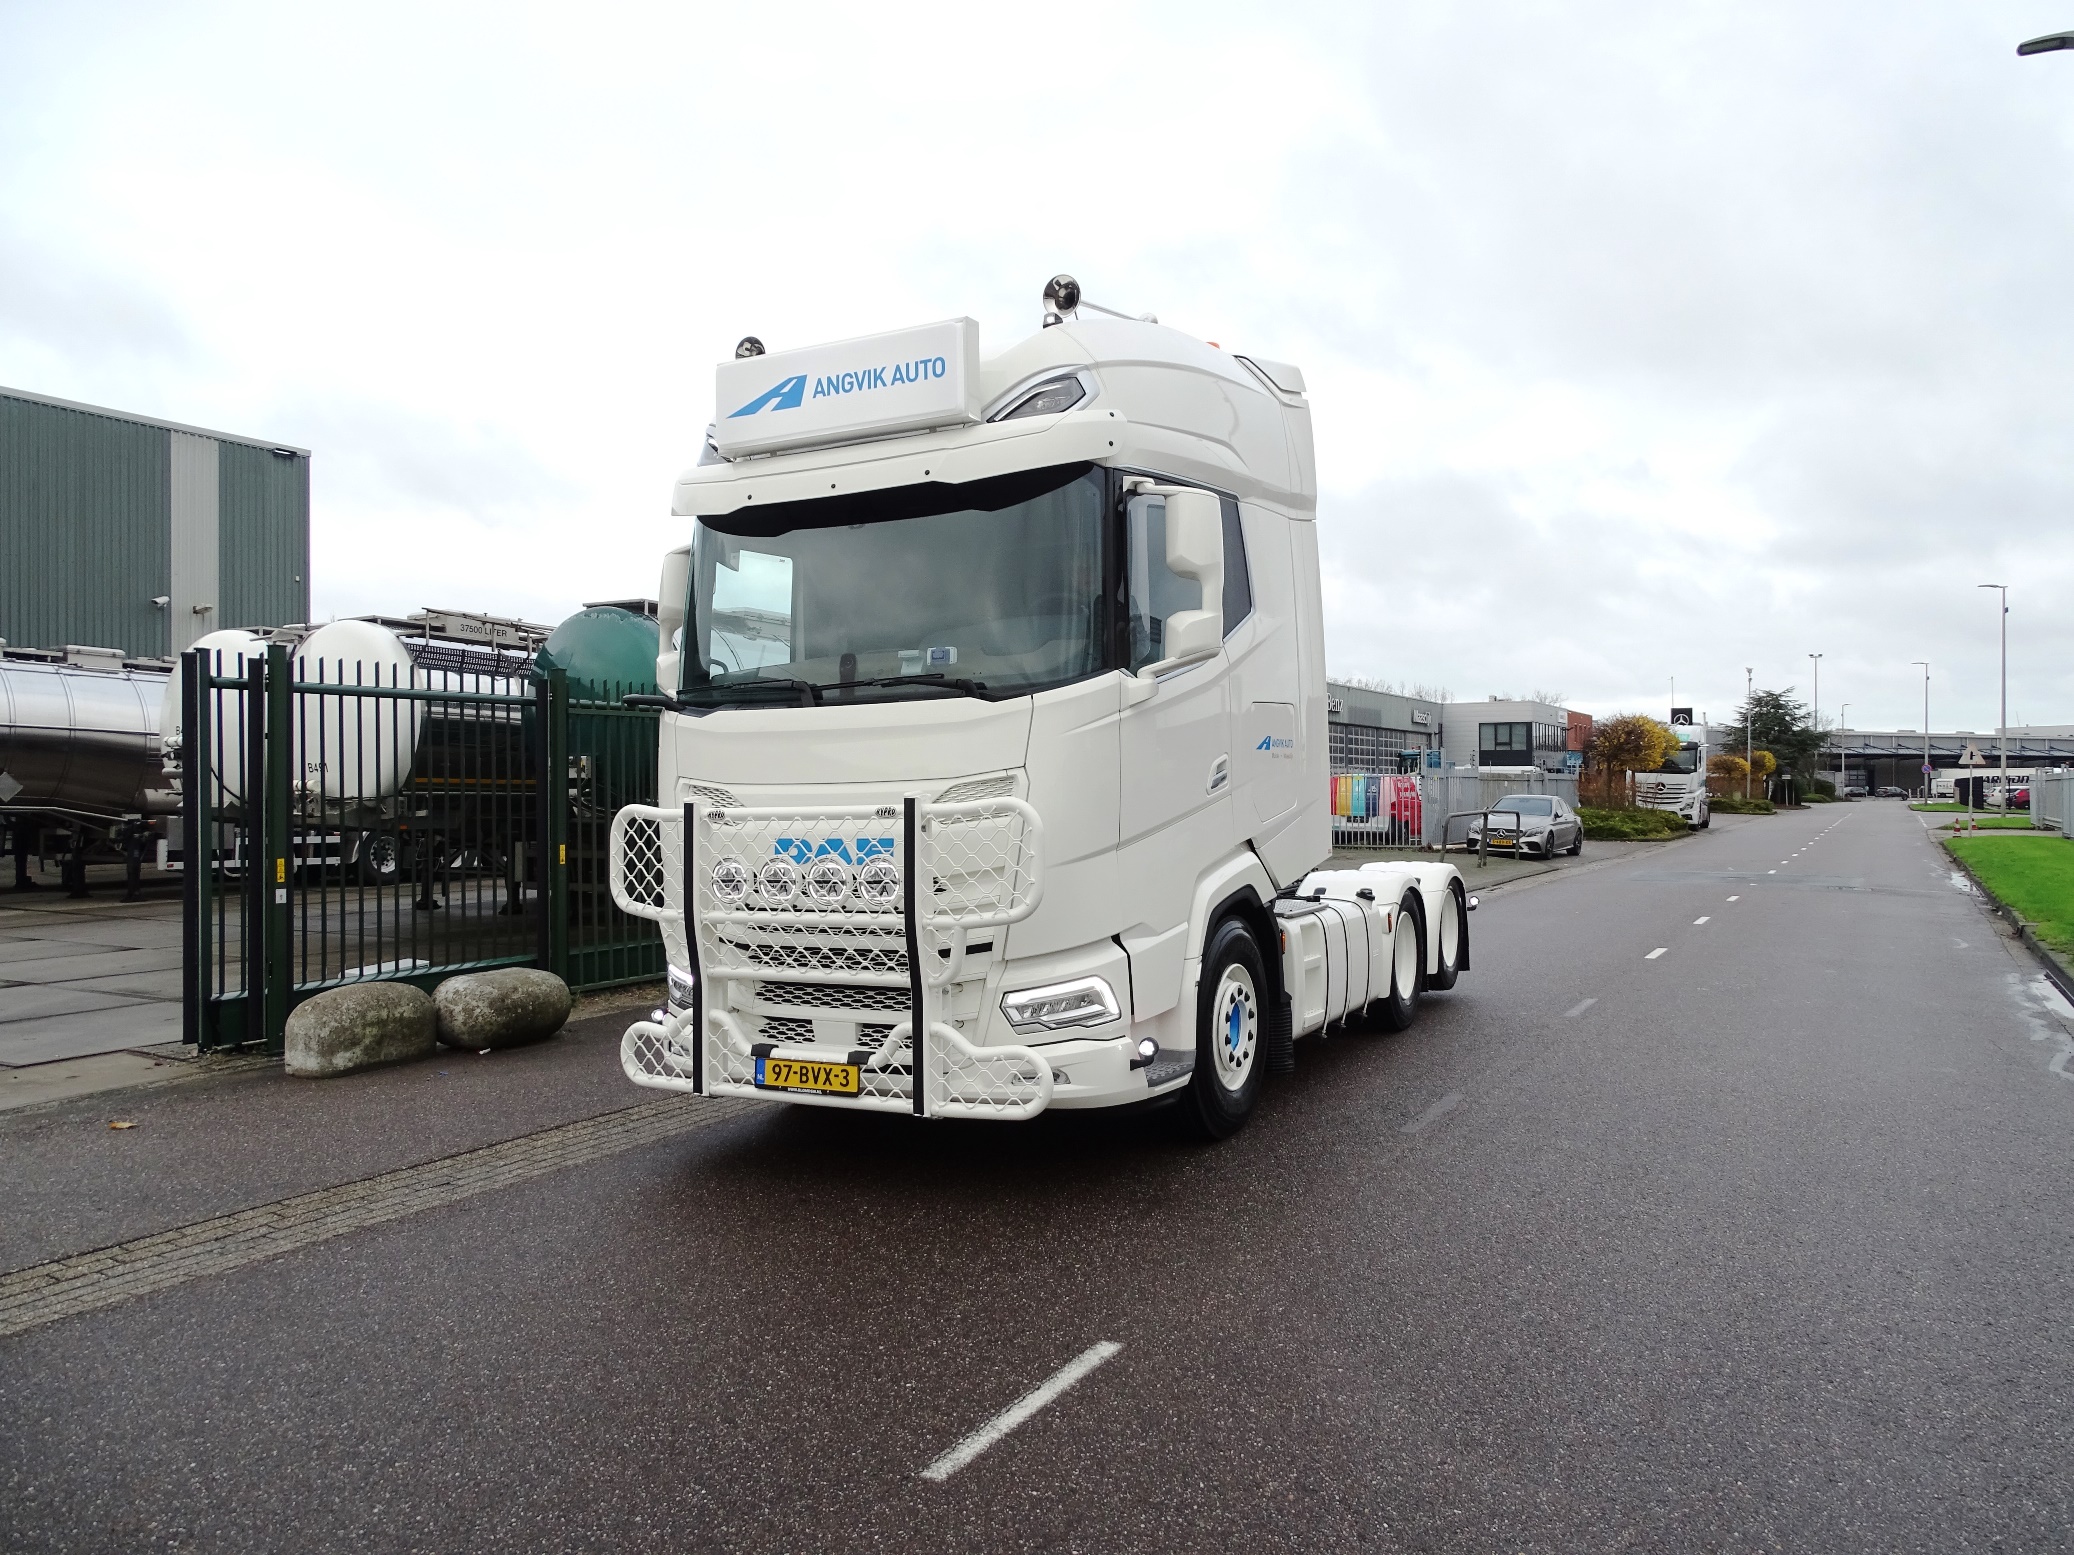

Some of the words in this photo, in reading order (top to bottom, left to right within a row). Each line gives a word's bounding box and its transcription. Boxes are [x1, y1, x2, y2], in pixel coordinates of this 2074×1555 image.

[812, 366, 888, 399] ANGVIK
[890, 356, 946, 386] AUTO
[460, 623, 483, 635] 37500
[774, 837, 894, 866] DAF
[771, 1063, 850, 1088] 97-BVX-3
